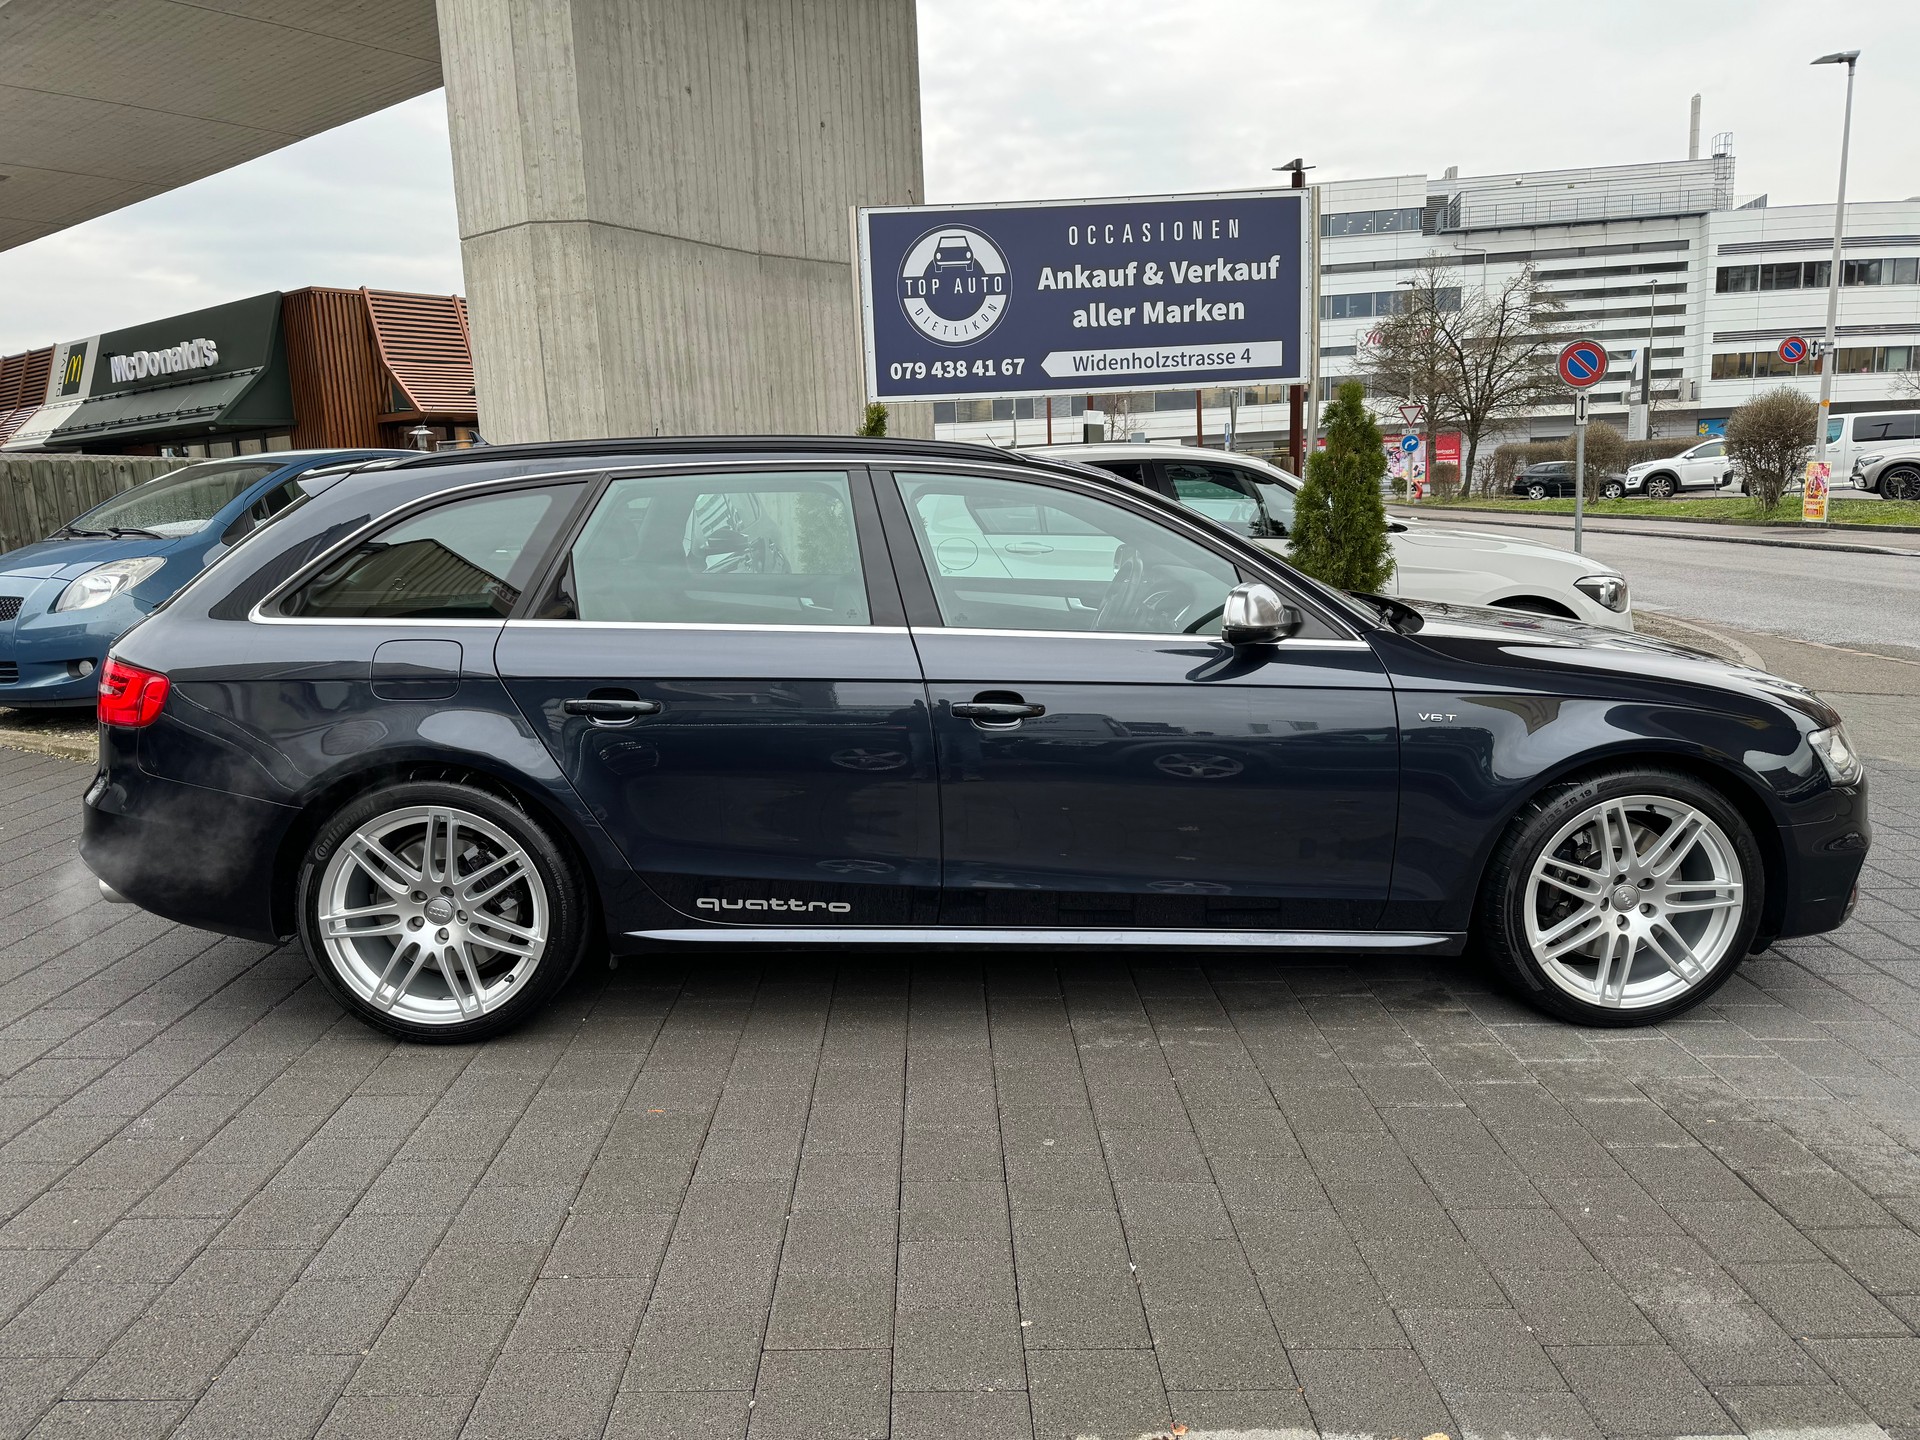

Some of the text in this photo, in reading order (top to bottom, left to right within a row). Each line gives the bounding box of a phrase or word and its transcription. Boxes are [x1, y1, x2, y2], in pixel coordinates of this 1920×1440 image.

[1068, 218, 1239, 246] OCCASIONEN
[1037, 254, 1281, 290] Ankauf & Verkauf
[905, 276, 1003, 296] TOP AUTO
[915, 303, 998, 337] DIETLIKON
[1072, 297, 1245, 328] aller Marken
[110, 338, 219, 384] McDonald's
[890, 358, 1025, 380] 079 438 41 67
[1072, 347, 1252, 373] Widenholzstrasse 4
[1562, 797, 1578, 809] ZR
[1579, 789, 1592, 798] 19
[696, 898, 851, 913] quattro
